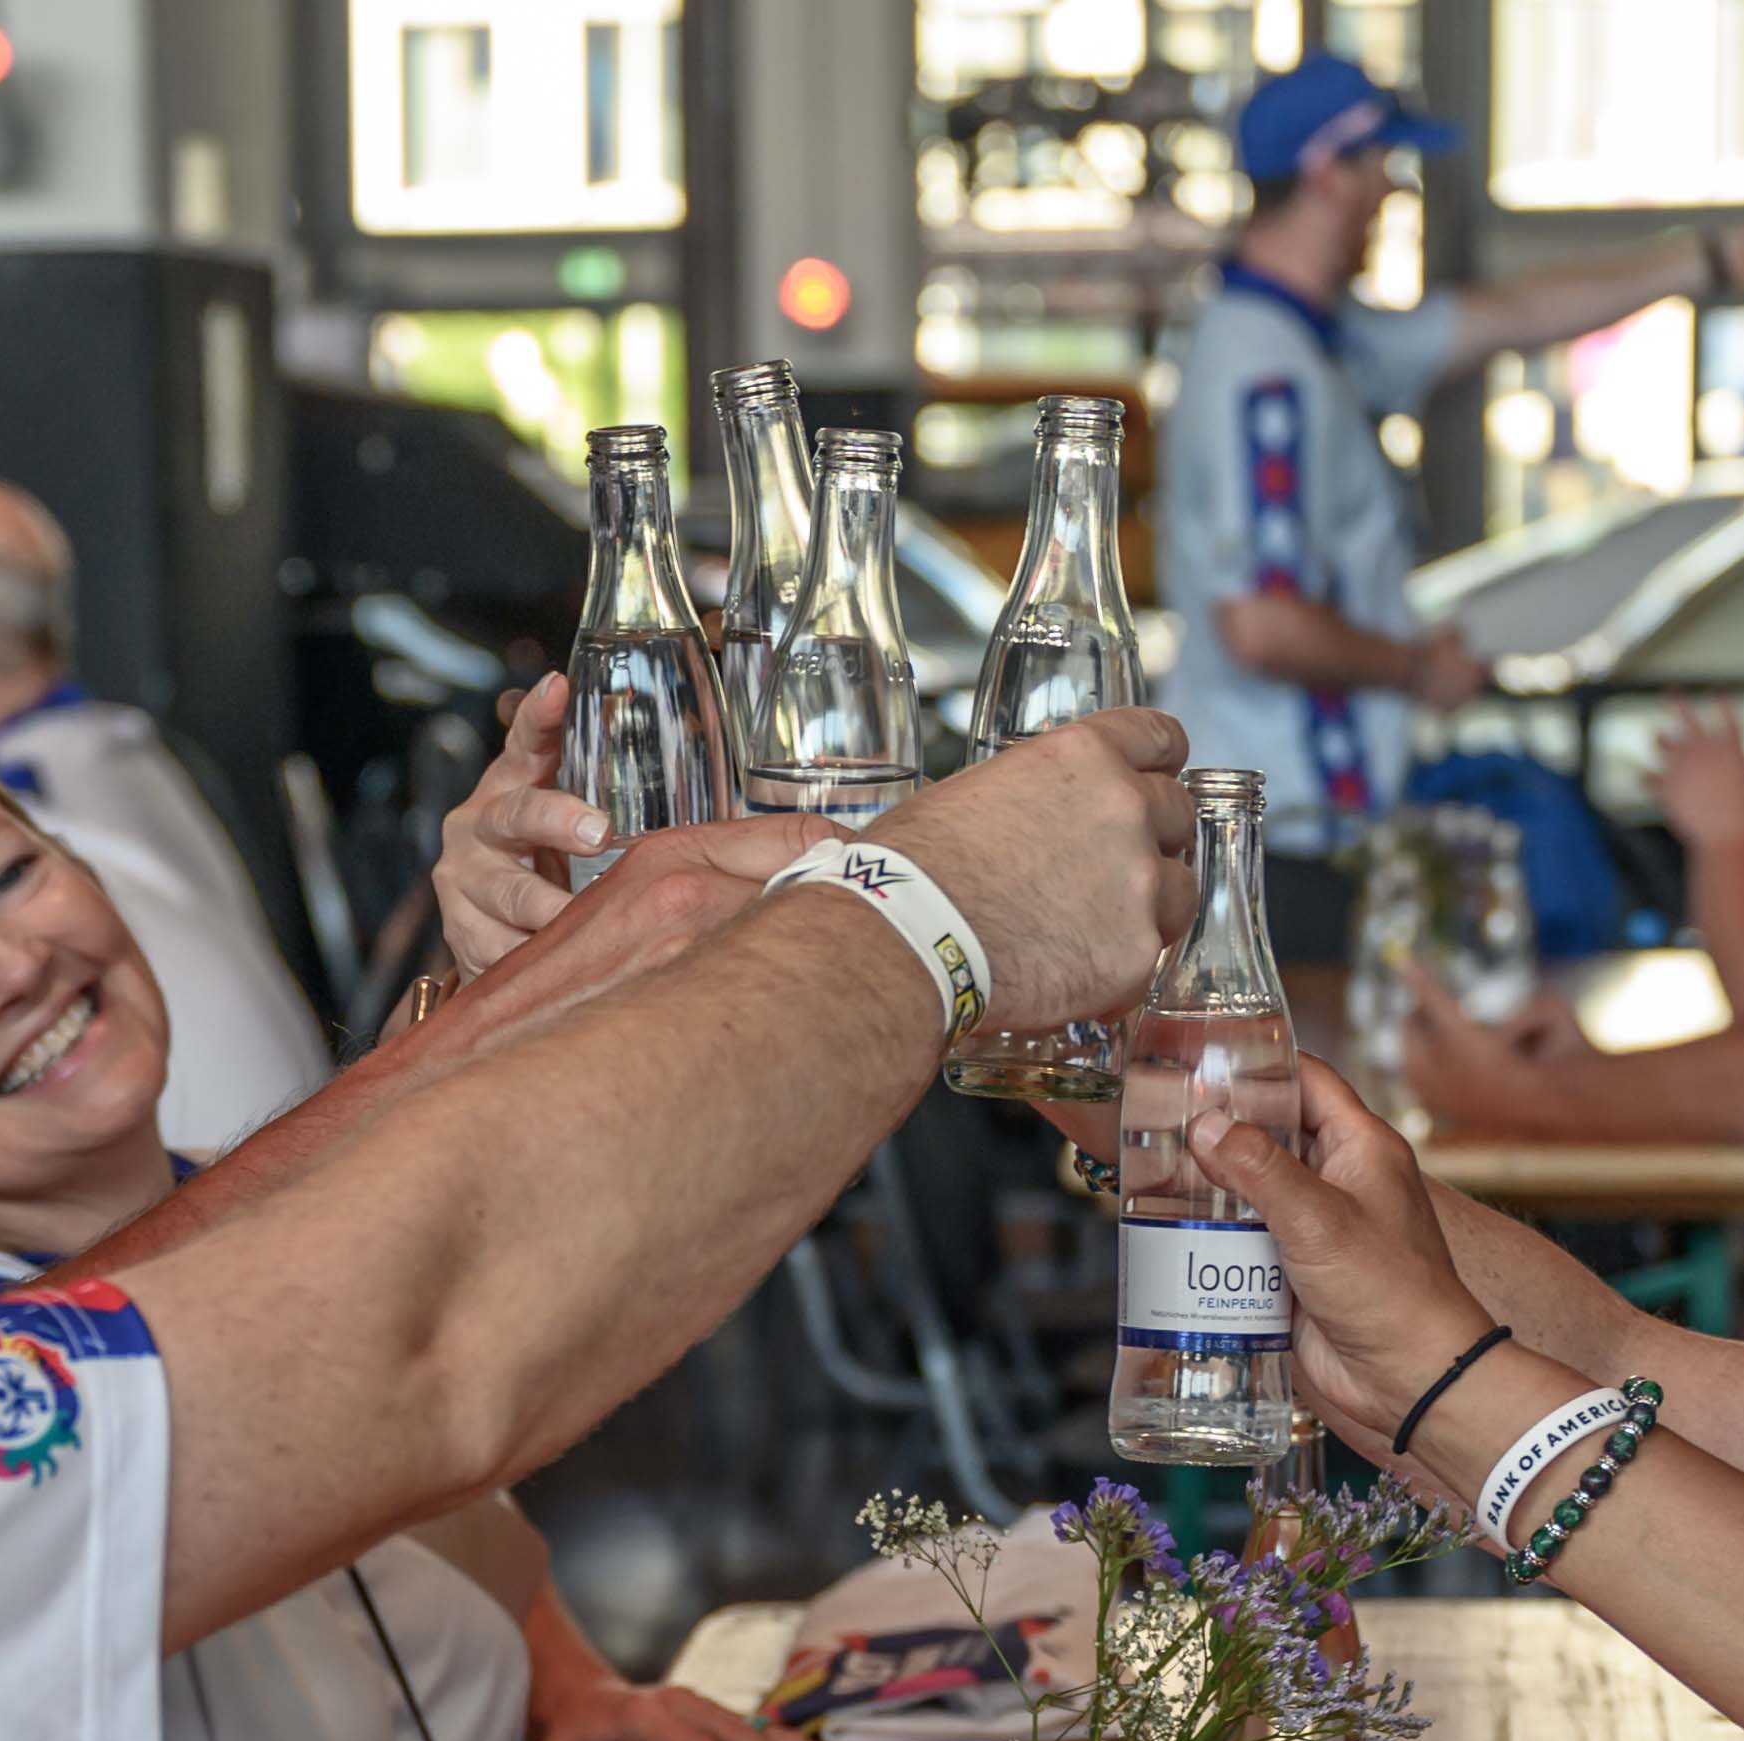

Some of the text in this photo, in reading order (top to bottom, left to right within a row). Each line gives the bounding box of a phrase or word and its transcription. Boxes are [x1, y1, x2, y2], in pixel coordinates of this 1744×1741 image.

[1187, 1251, 1283, 1292] loona
[1487, 1397, 1630, 1527] BANK OF AMERICA
